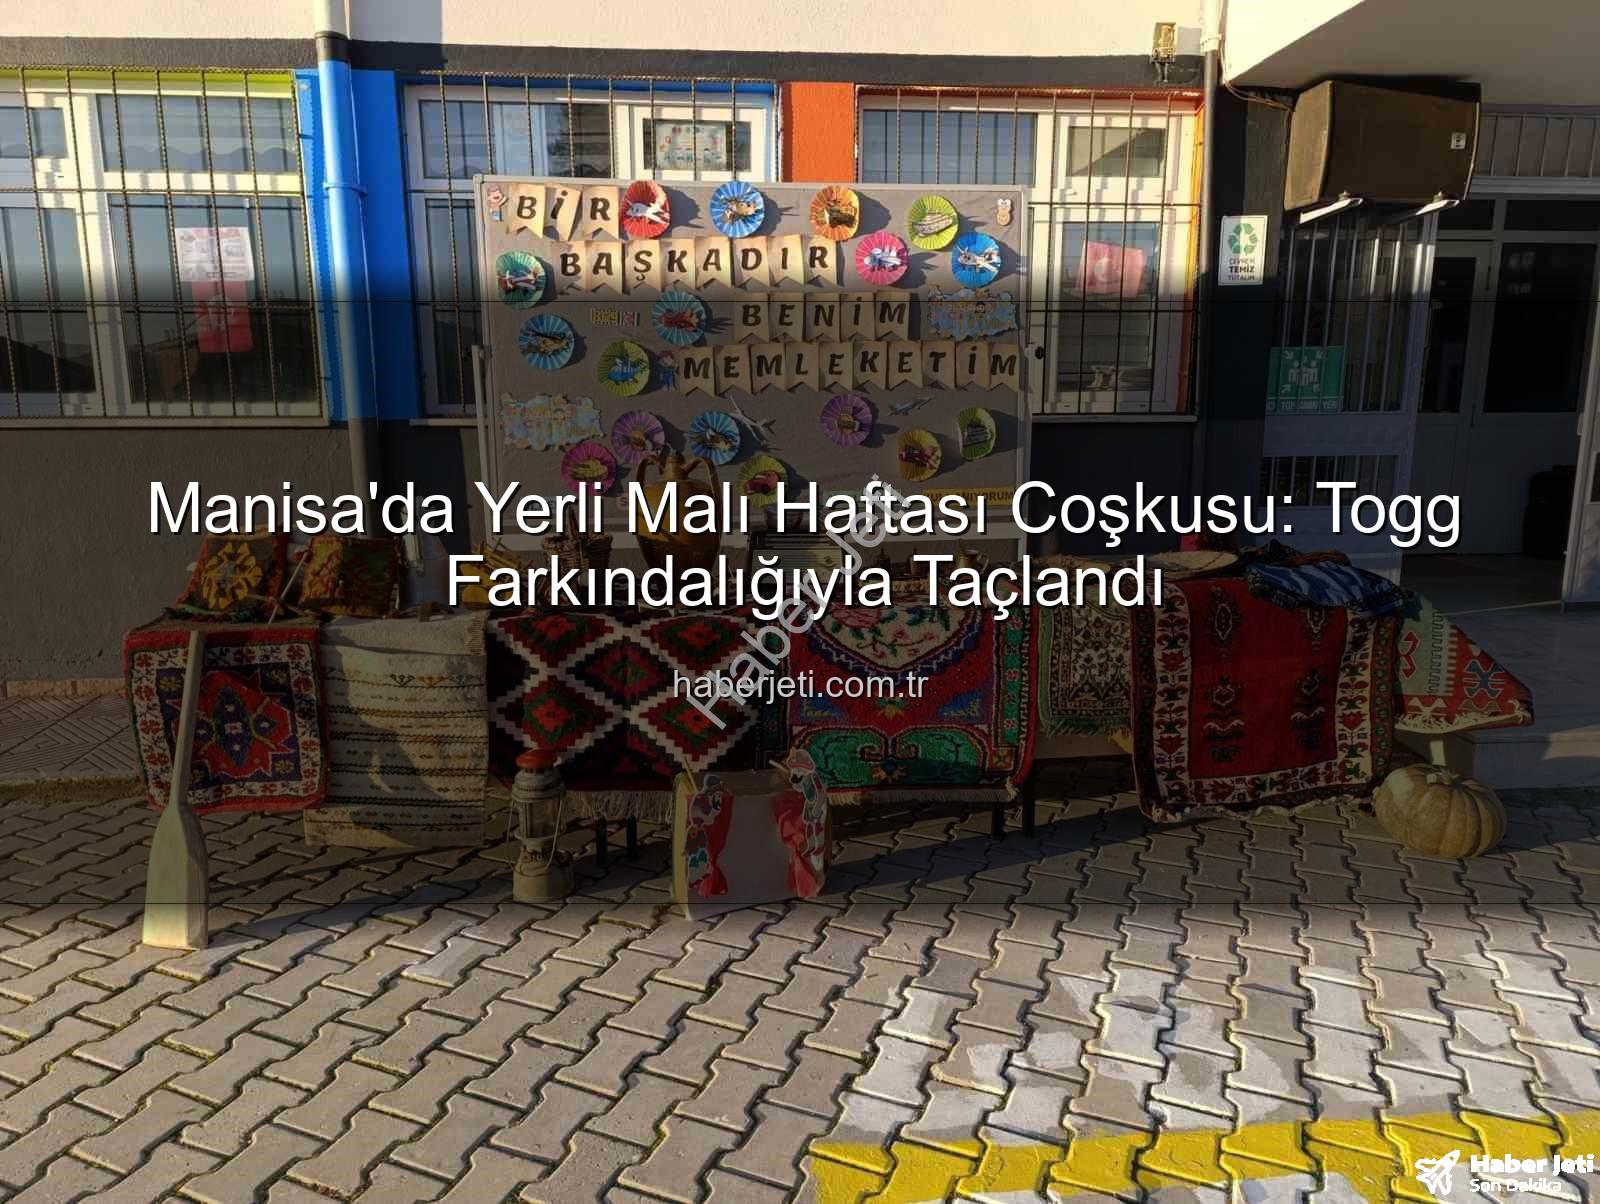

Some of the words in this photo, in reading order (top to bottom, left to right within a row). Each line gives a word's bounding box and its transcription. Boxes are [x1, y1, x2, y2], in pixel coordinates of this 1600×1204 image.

[515, 189, 611, 222] BİR
[559, 245, 831, 281] BAŞKADIR
[1228, 264, 1255, 274] TEMİZ
[740, 297, 907, 327] BENİM
[683, 347, 1018, 380] MEMLEKETİM
